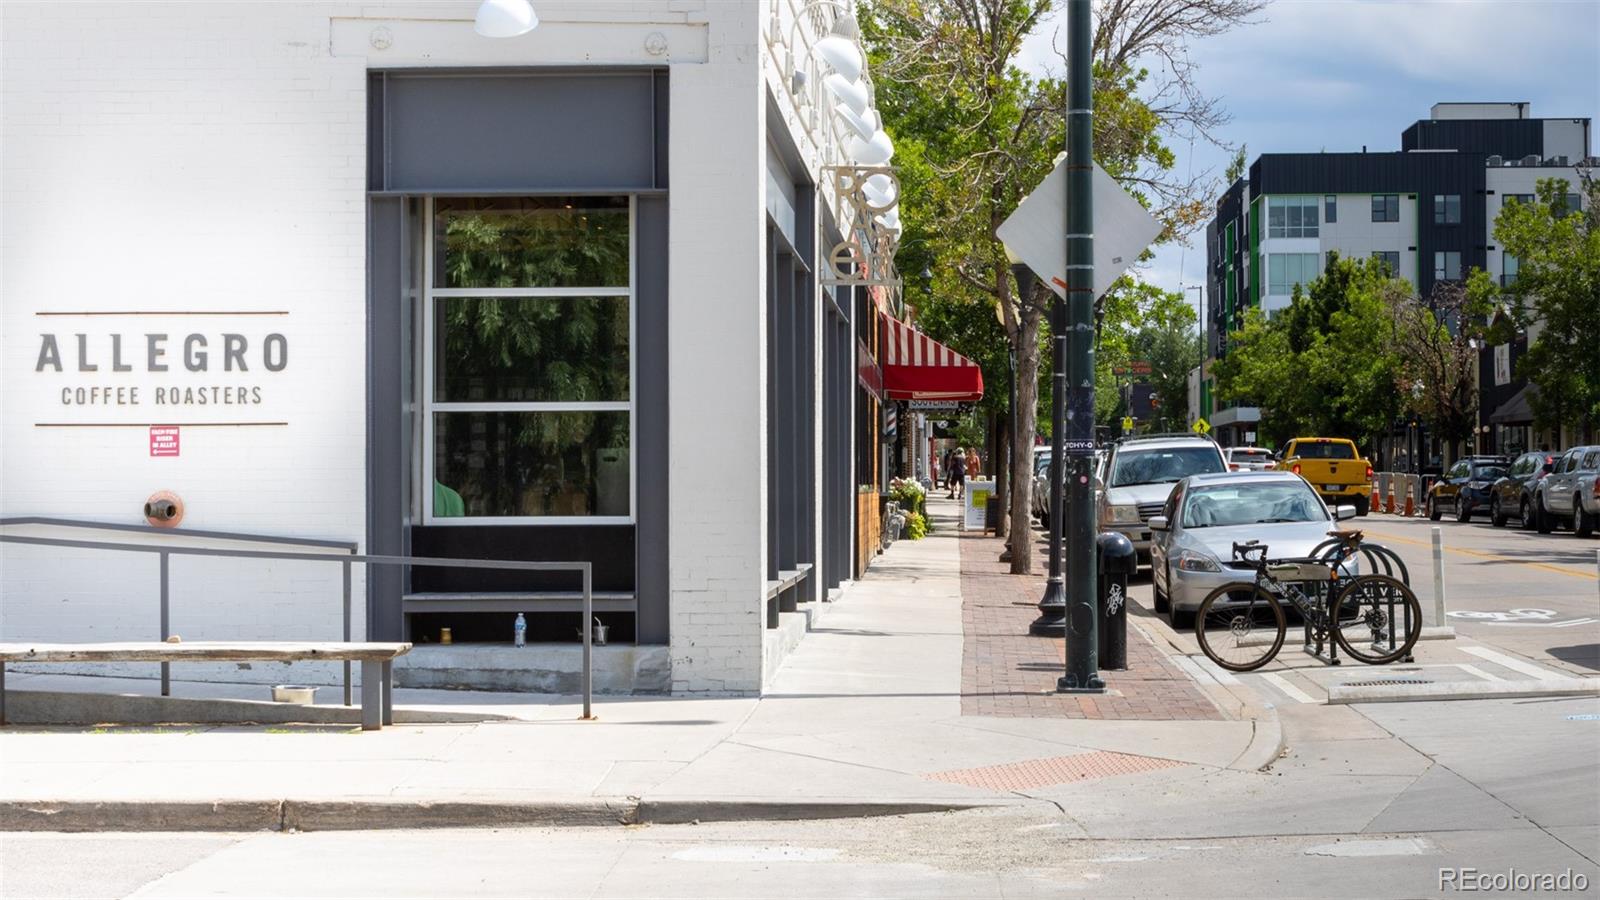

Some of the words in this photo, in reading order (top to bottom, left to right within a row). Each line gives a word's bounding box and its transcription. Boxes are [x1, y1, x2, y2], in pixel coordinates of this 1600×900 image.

[35, 333, 288, 372] ALLEGRO
[62, 387, 140, 405] COFFEE
[155, 386, 262, 405] ROASTERS
